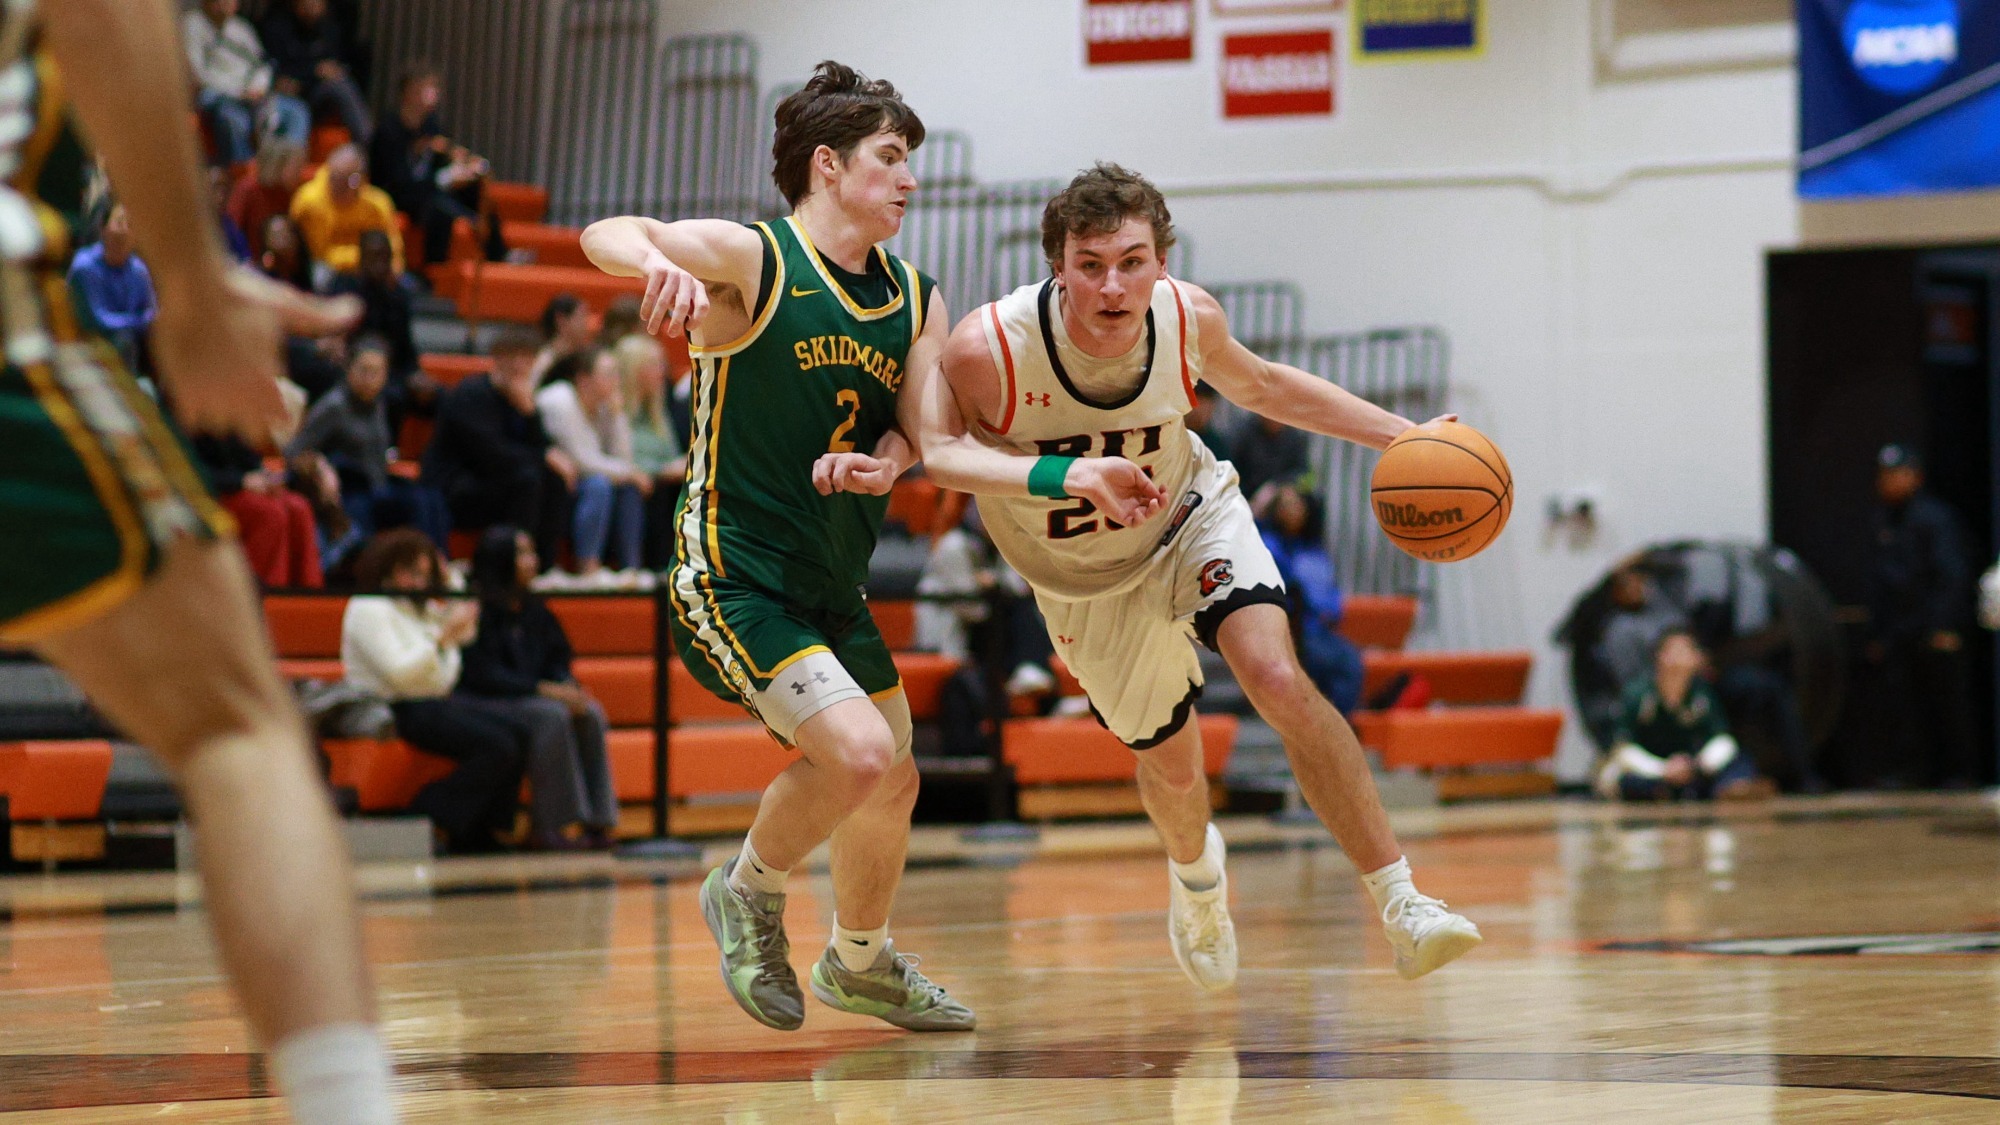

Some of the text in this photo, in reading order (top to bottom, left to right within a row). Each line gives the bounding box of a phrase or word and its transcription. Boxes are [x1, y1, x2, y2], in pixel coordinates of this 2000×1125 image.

[828, 389, 860, 453] 2
[1047, 465, 1154, 539] 2
[1378, 502, 1464, 527] Wilson
